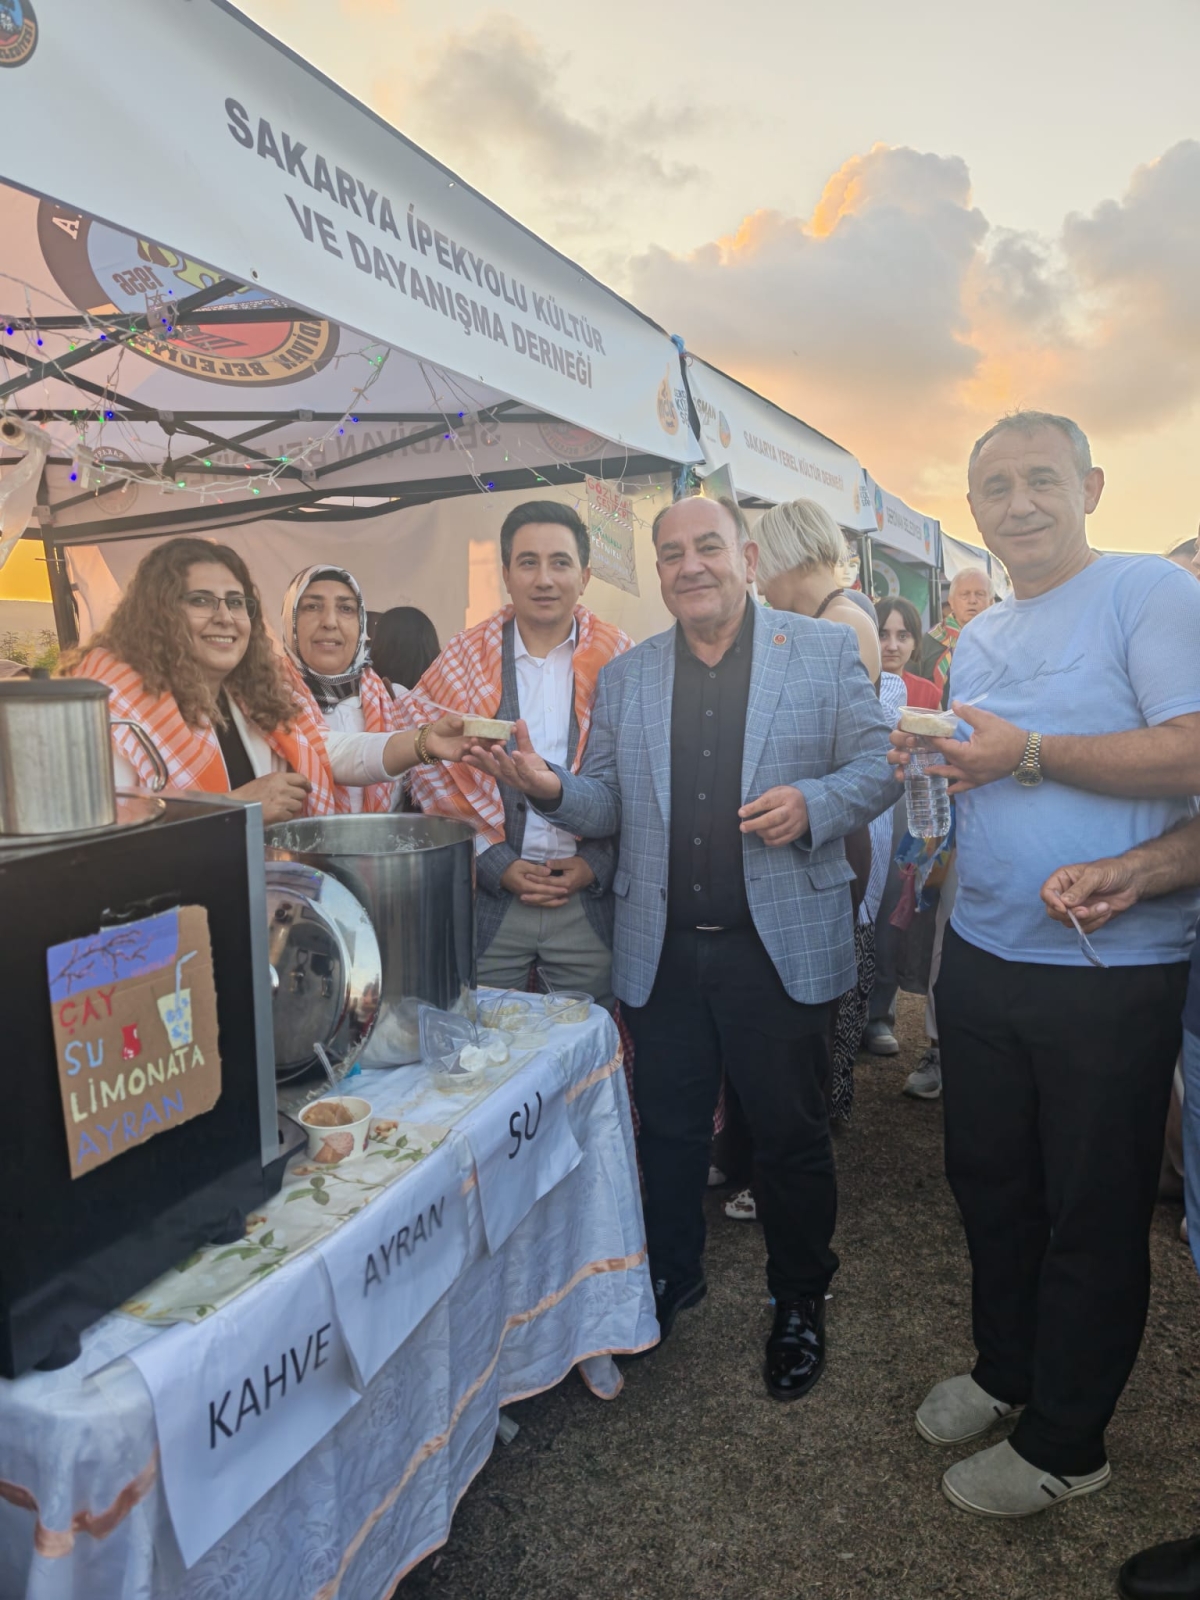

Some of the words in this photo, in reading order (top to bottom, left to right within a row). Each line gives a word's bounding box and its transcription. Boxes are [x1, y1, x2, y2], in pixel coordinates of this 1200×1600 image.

[225, 97, 401, 241] SAKARYA
[407, 203, 528, 313] İPEKYOLU
[532, 291, 606, 356] KÜLTÜR
[284, 193, 343, 260] VE
[346, 230, 509, 347] DAYANIŞMA
[511, 321, 592, 389] DERNEĞİ
[59, 986, 117, 1035] ÇAY
[64, 1040, 104, 1076] SU
[70, 1044, 205, 1123] LİMONATA
[77, 1090, 185, 1166] AYRAN
[508, 1092, 543, 1160] SU
[363, 1197, 445, 1297] AYRAN
[209, 1323, 331, 1450] KAHVE
